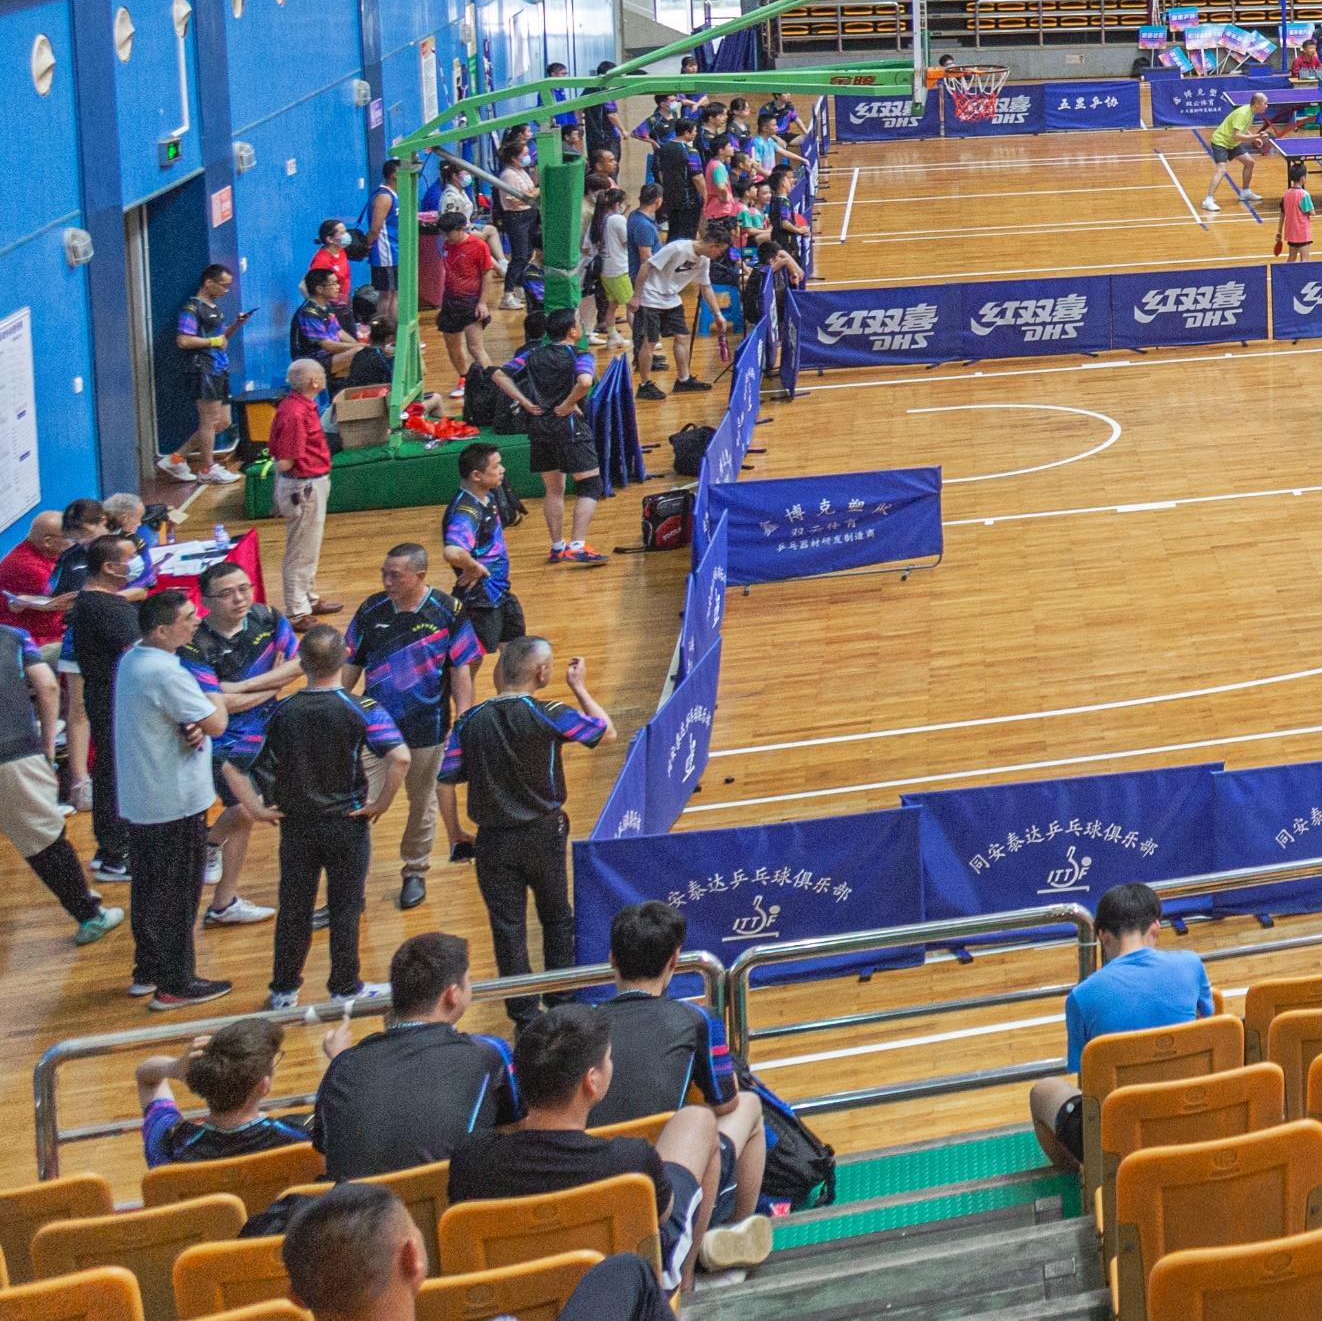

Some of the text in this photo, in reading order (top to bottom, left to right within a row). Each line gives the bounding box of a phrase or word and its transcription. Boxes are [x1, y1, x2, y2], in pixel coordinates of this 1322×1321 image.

[991, 112, 1030, 124] DHS
[970, 293, 1088, 335] 红双喜
[1134, 281, 1246, 323] 红双喜
[1184, 308, 1244, 328] DHS
[817, 303, 938, 345] 红双喜
[869, 330, 935, 351] DHS
[1023, 321, 1085, 342] DHS
[969, 819, 1158, 875] 同安泰达乒乓球俱乐部
[667, 867, 854, 908] 安泰达乒乓球俱乐部
